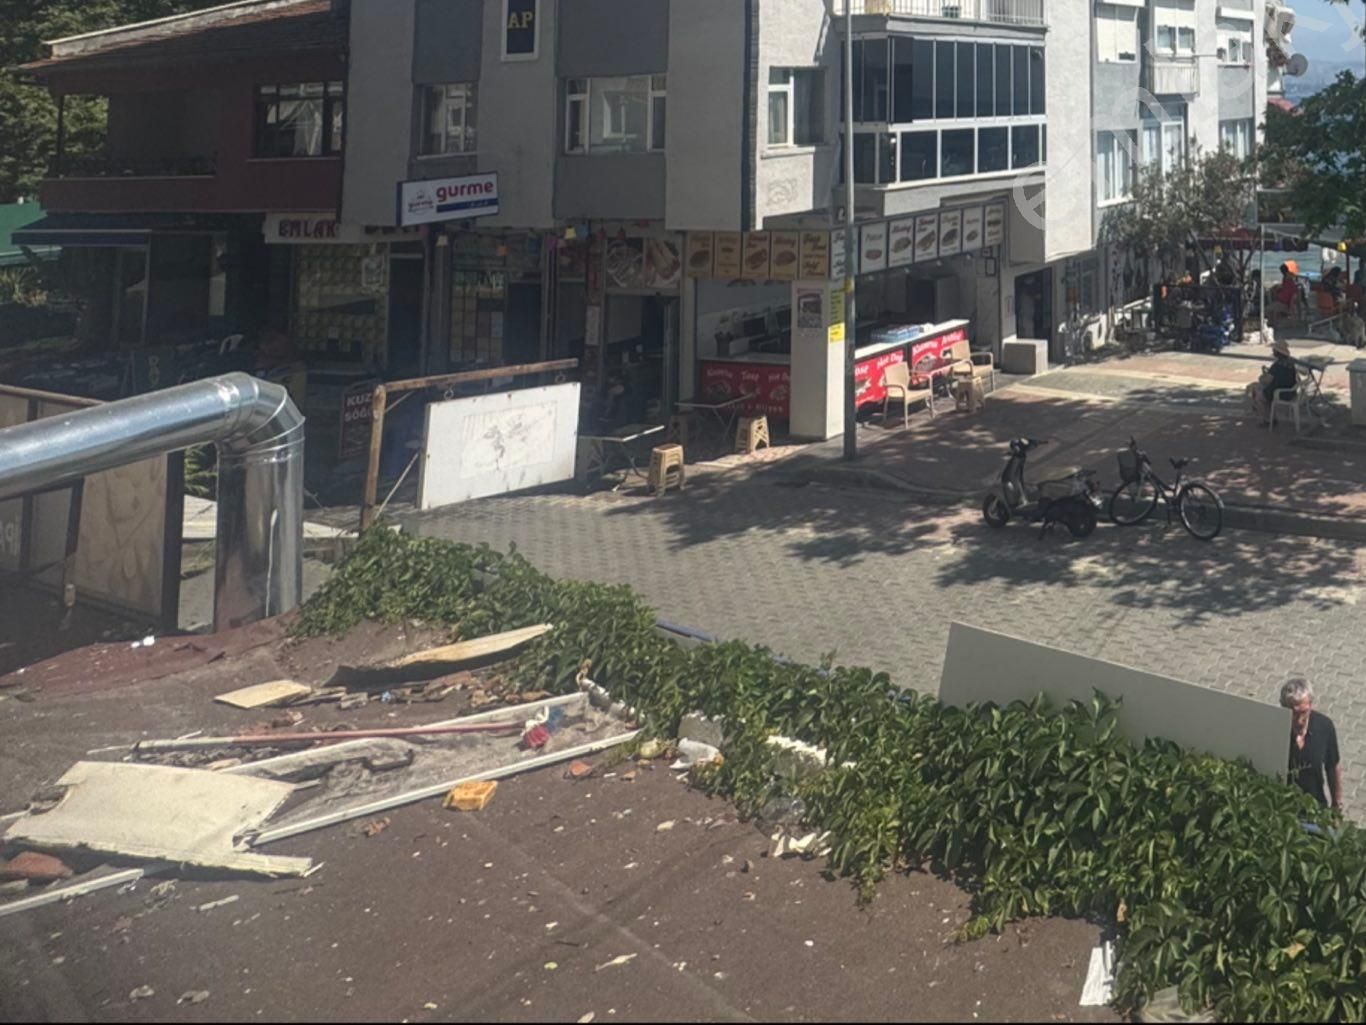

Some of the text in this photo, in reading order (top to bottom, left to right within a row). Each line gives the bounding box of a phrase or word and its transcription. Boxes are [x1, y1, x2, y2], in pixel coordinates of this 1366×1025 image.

[508, 11, 533, 29] AP
[436, 181, 494, 202] gurme
[279, 220, 336, 238] EMLAK
